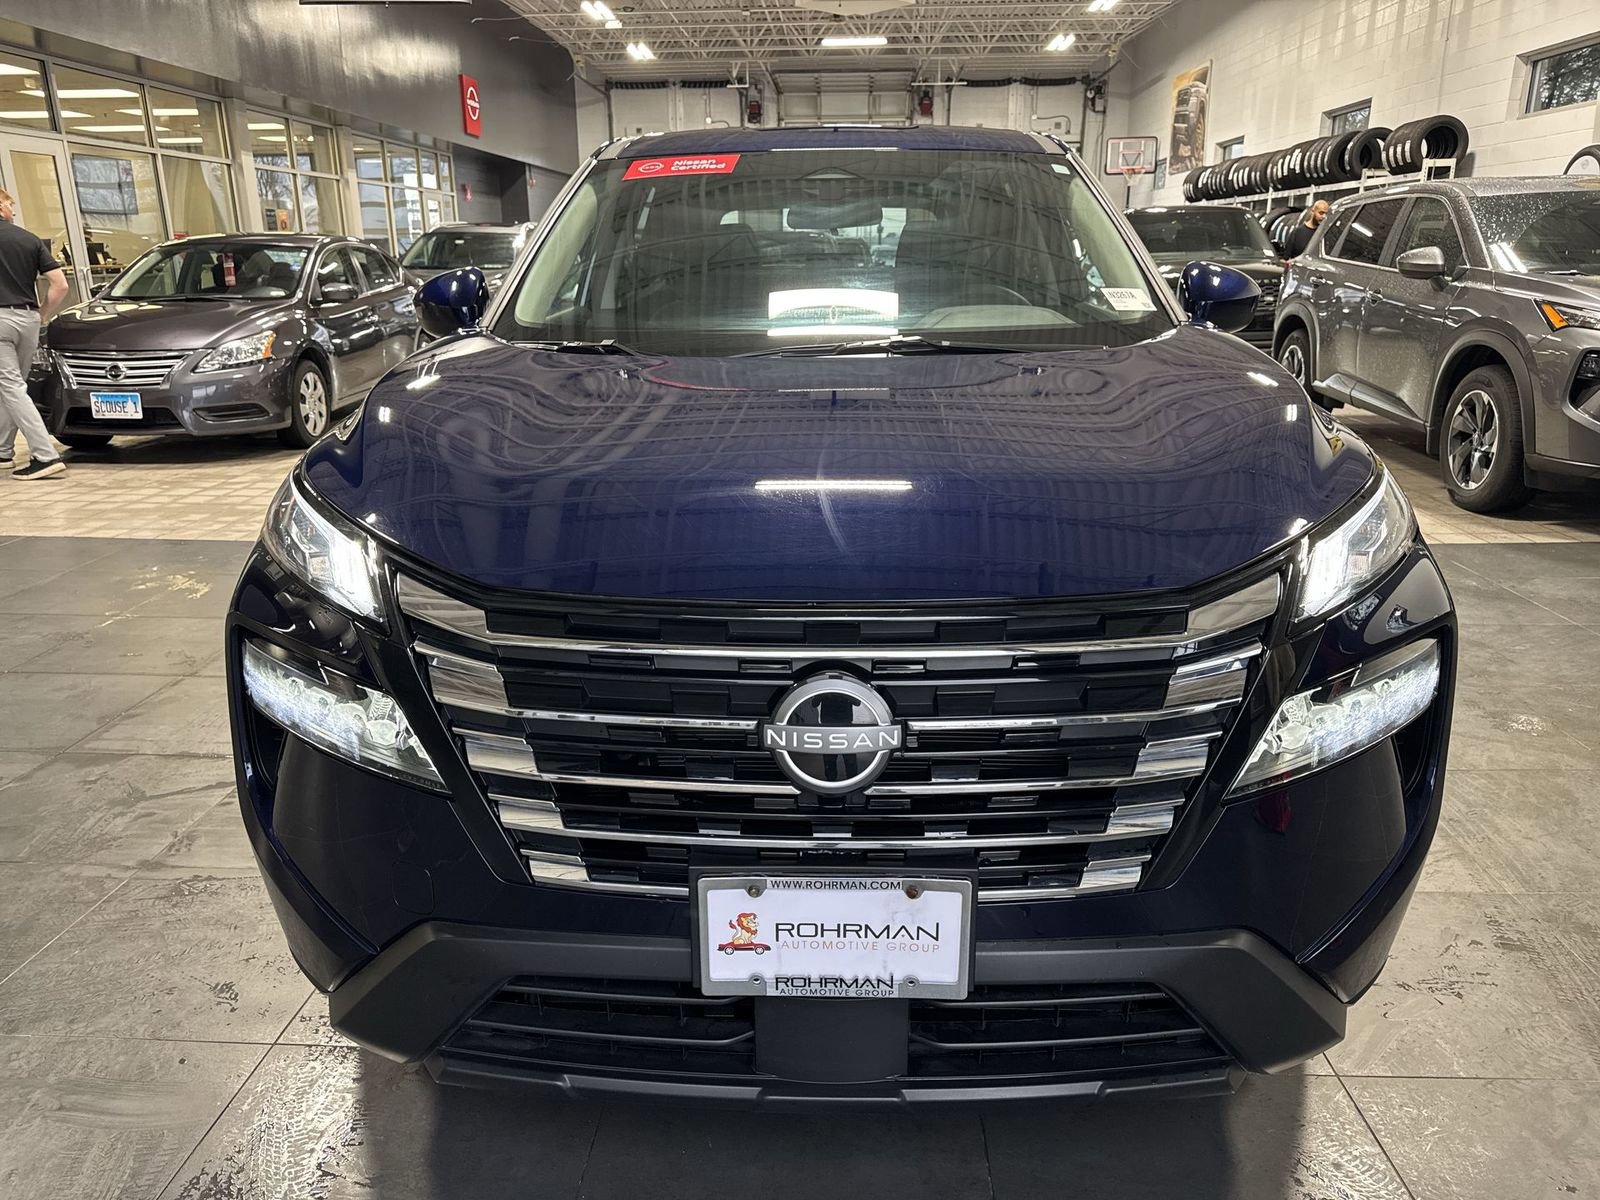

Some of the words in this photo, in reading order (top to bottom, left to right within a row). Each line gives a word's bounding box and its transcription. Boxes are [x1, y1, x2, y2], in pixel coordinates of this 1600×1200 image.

[671, 163, 726, 171] Certified
[94, 400, 128, 413] SCOUSE
[133, 401, 139, 413] 1
[767, 729, 898, 749] NISSAN
[771, 880, 901, 891] WWW.ROHRMAN.COM
[775, 922, 940, 942] ROHRMAN
[780, 940, 878, 951] AUTOMOTIVE
[886, 941, 940, 953] GROUP
[775, 975, 894, 991] ROHRMAN
[779, 988, 850, 997] AUTOMOTIVE
[855, 989, 894, 997] GROUP
